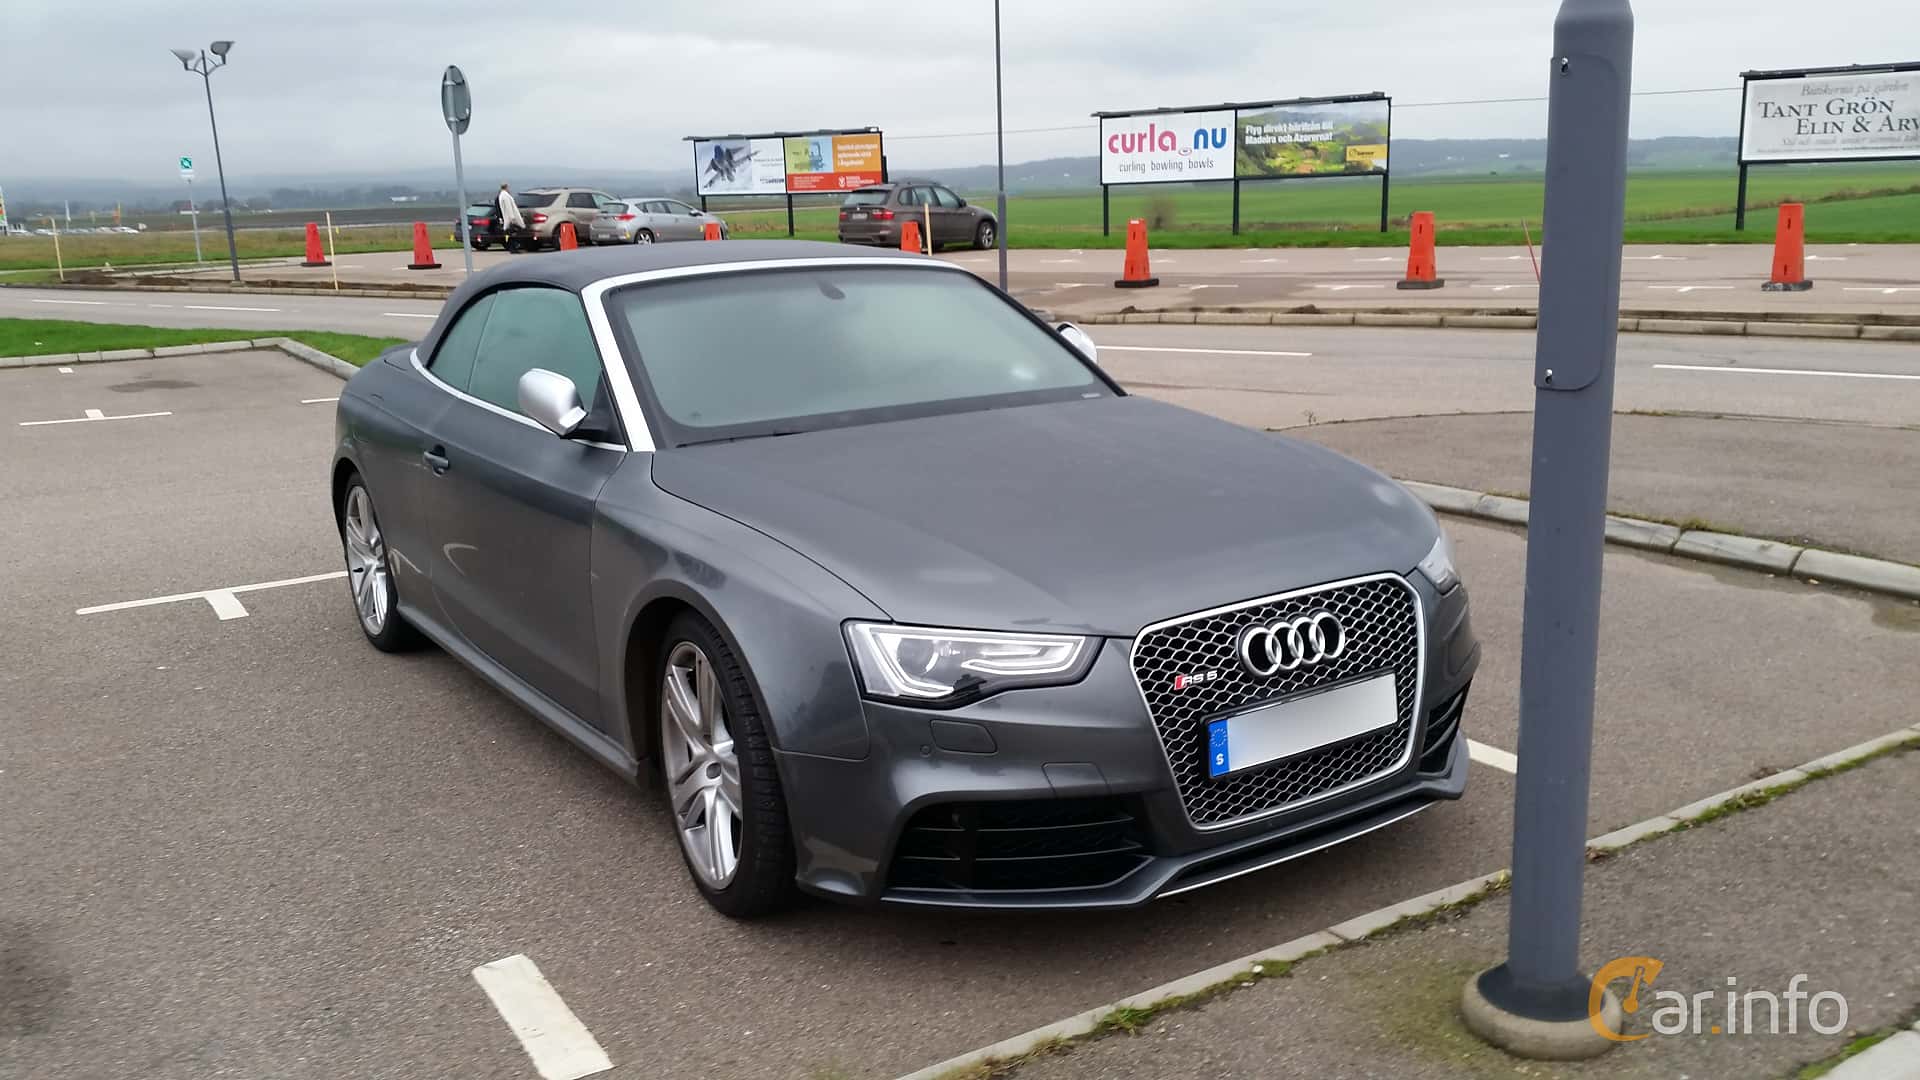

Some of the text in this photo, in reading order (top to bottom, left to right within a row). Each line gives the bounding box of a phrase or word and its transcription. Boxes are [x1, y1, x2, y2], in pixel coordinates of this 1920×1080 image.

[1758, 96, 1895, 119] TANT GRÖN
[1245, 124, 1262, 135] Flyg
[1796, 118, 1845, 136] ELIN
[1852, 115, 1872, 133] &
[1245, 134, 1276, 145] Madeira
[1277, 133, 1292, 143] och
[1119, 158, 1214, 174] curling bowling bowls
[1215, 753, 1225, 766] S
